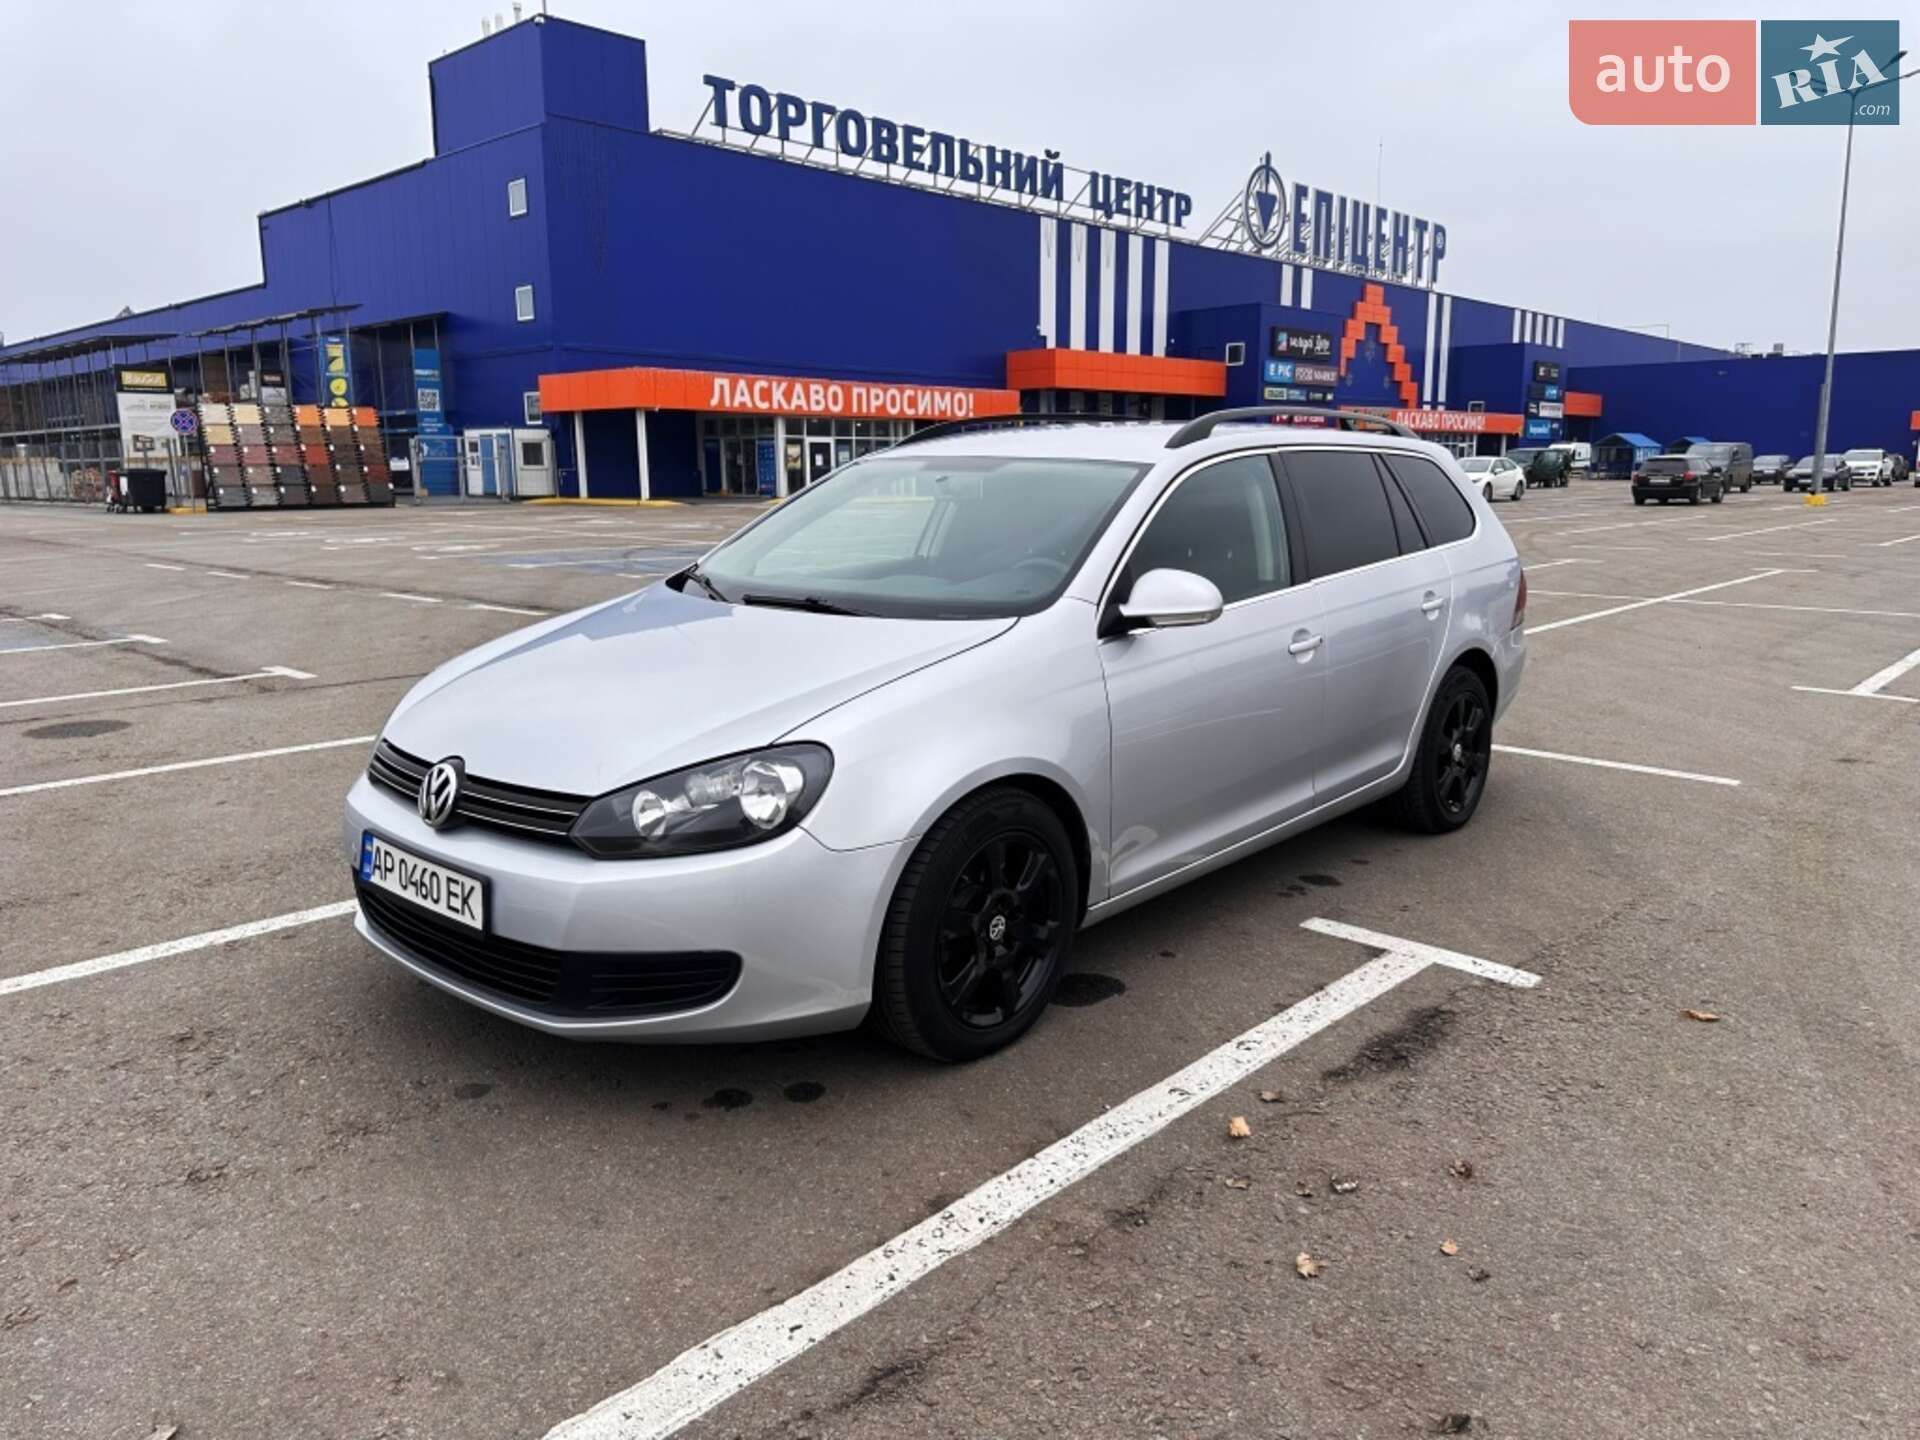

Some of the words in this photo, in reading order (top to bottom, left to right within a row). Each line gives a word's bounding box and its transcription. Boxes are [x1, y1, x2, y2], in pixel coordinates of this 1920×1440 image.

[703, 74, 1065, 200] ТОРГОВЕЛЬНИЙ
[1089, 170, 1193, 228] ЦЕНТР
[1289, 181, 1447, 284] ЕПІЦЕНТР
[710, 377, 844, 413] ЛАСКАВО
[852, 386, 975, 417] ПРОСИМО!
[1396, 411, 1440, 429] ЛАСКАВО
[1441, 413, 1486, 431] ПРОСИМО!
[372, 846, 394, 881] AP
[399, 858, 441, 904] 0460
[446, 876, 478, 921] EK
